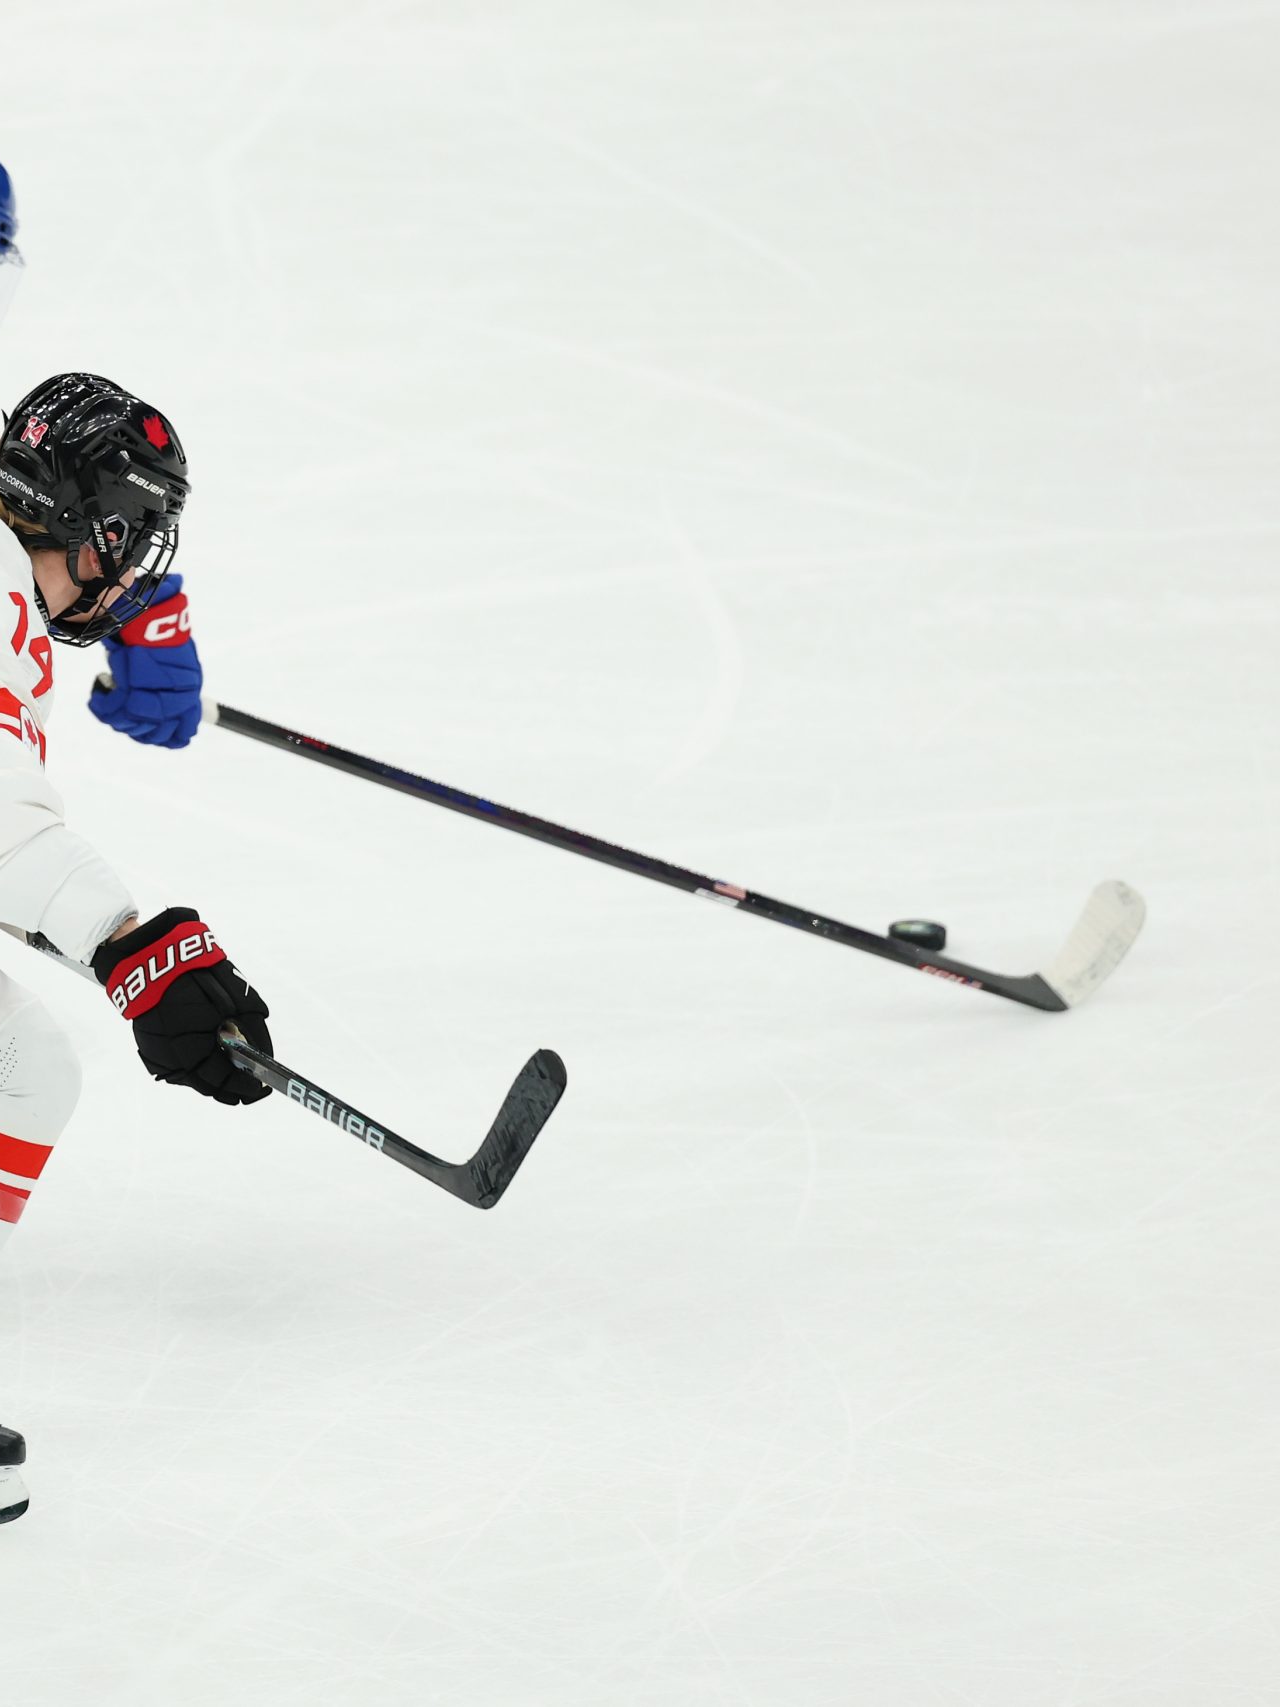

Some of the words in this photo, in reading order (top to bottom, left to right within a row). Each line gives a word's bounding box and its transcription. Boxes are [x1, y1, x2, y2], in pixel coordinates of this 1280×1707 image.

[20, 416, 49, 449] 14
[5, 474, 35, 498] CORTINA
[35, 492, 56, 508] 2026
[91, 520, 108, 553] AUER
[7, 591, 54, 699] 14
